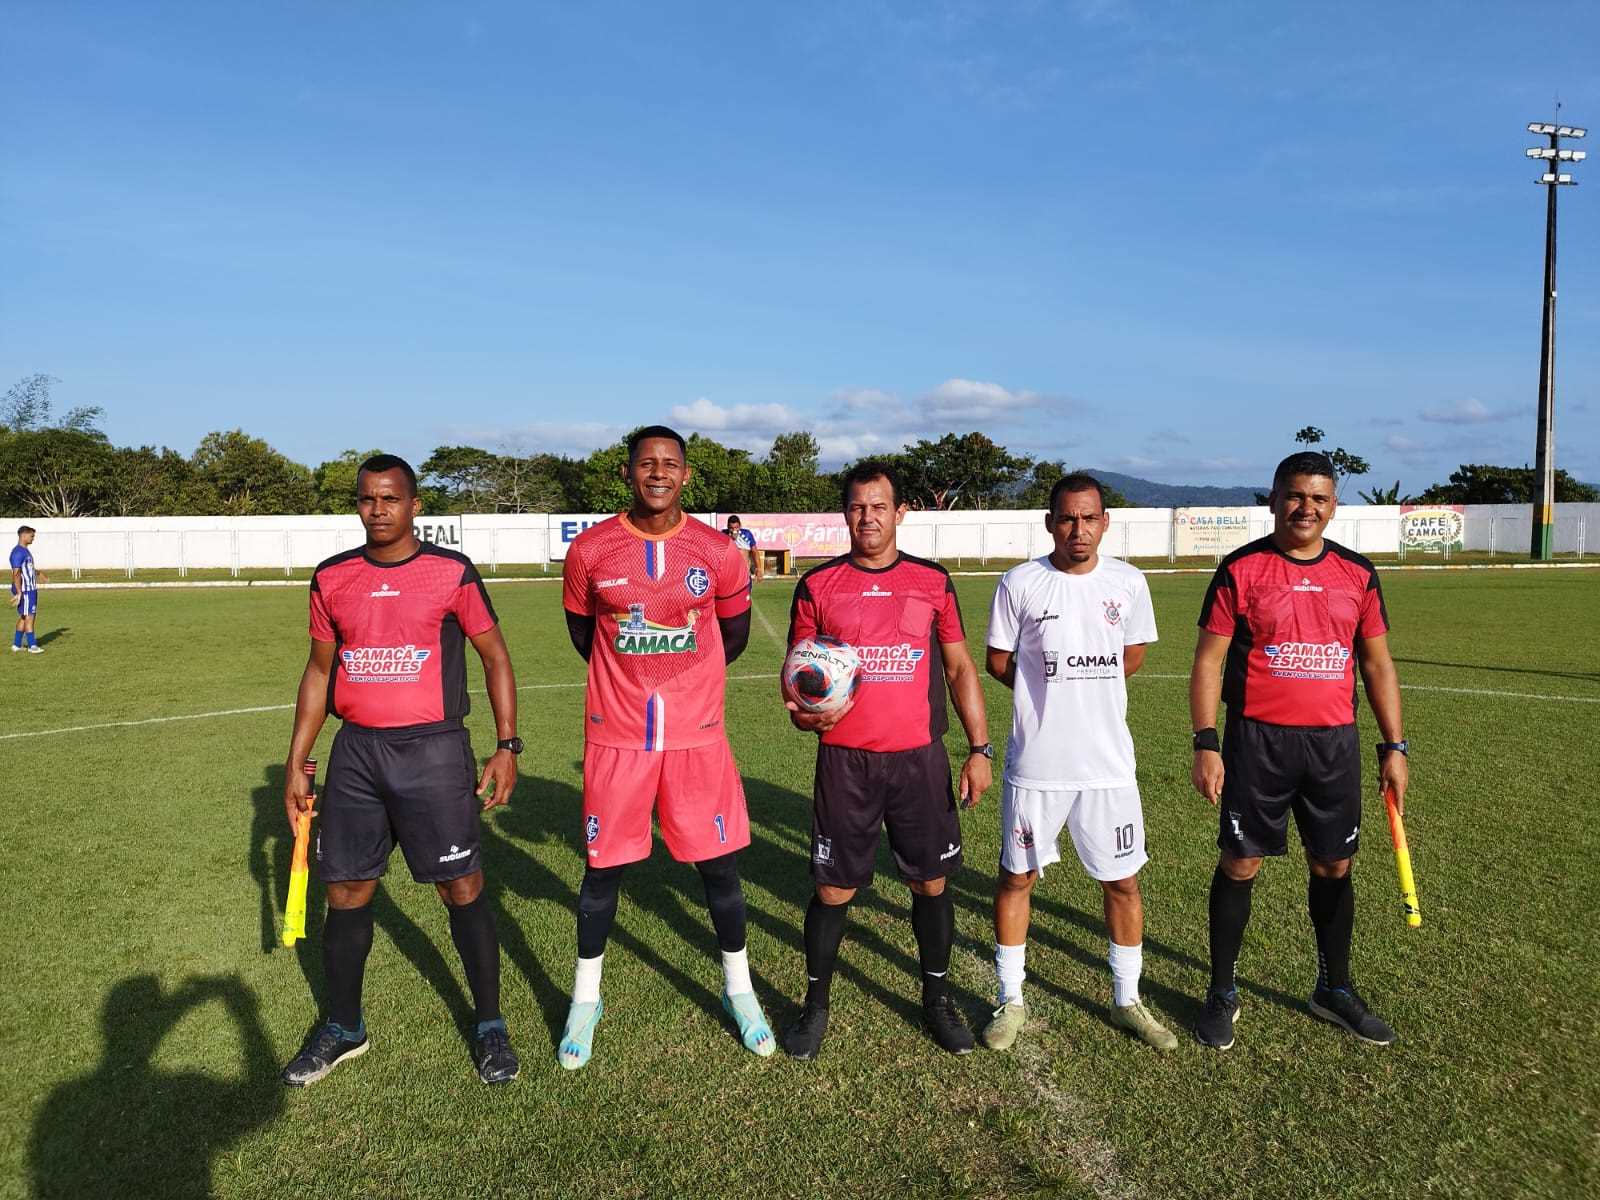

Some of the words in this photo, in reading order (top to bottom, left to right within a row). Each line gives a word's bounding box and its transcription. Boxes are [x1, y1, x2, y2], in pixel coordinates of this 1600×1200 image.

[1216, 516, 1247, 525] BELLA
[856, 644, 910, 659] AMACÃ
[346, 661, 419, 672] ESPORTES
[793, 650, 848, 670] PENALTY
[860, 660, 914, 671] PORTES
[1270, 656, 1345, 669] ESPORTES
[714, 815, 726, 844] 1
[1114, 823, 1133, 851] 10
